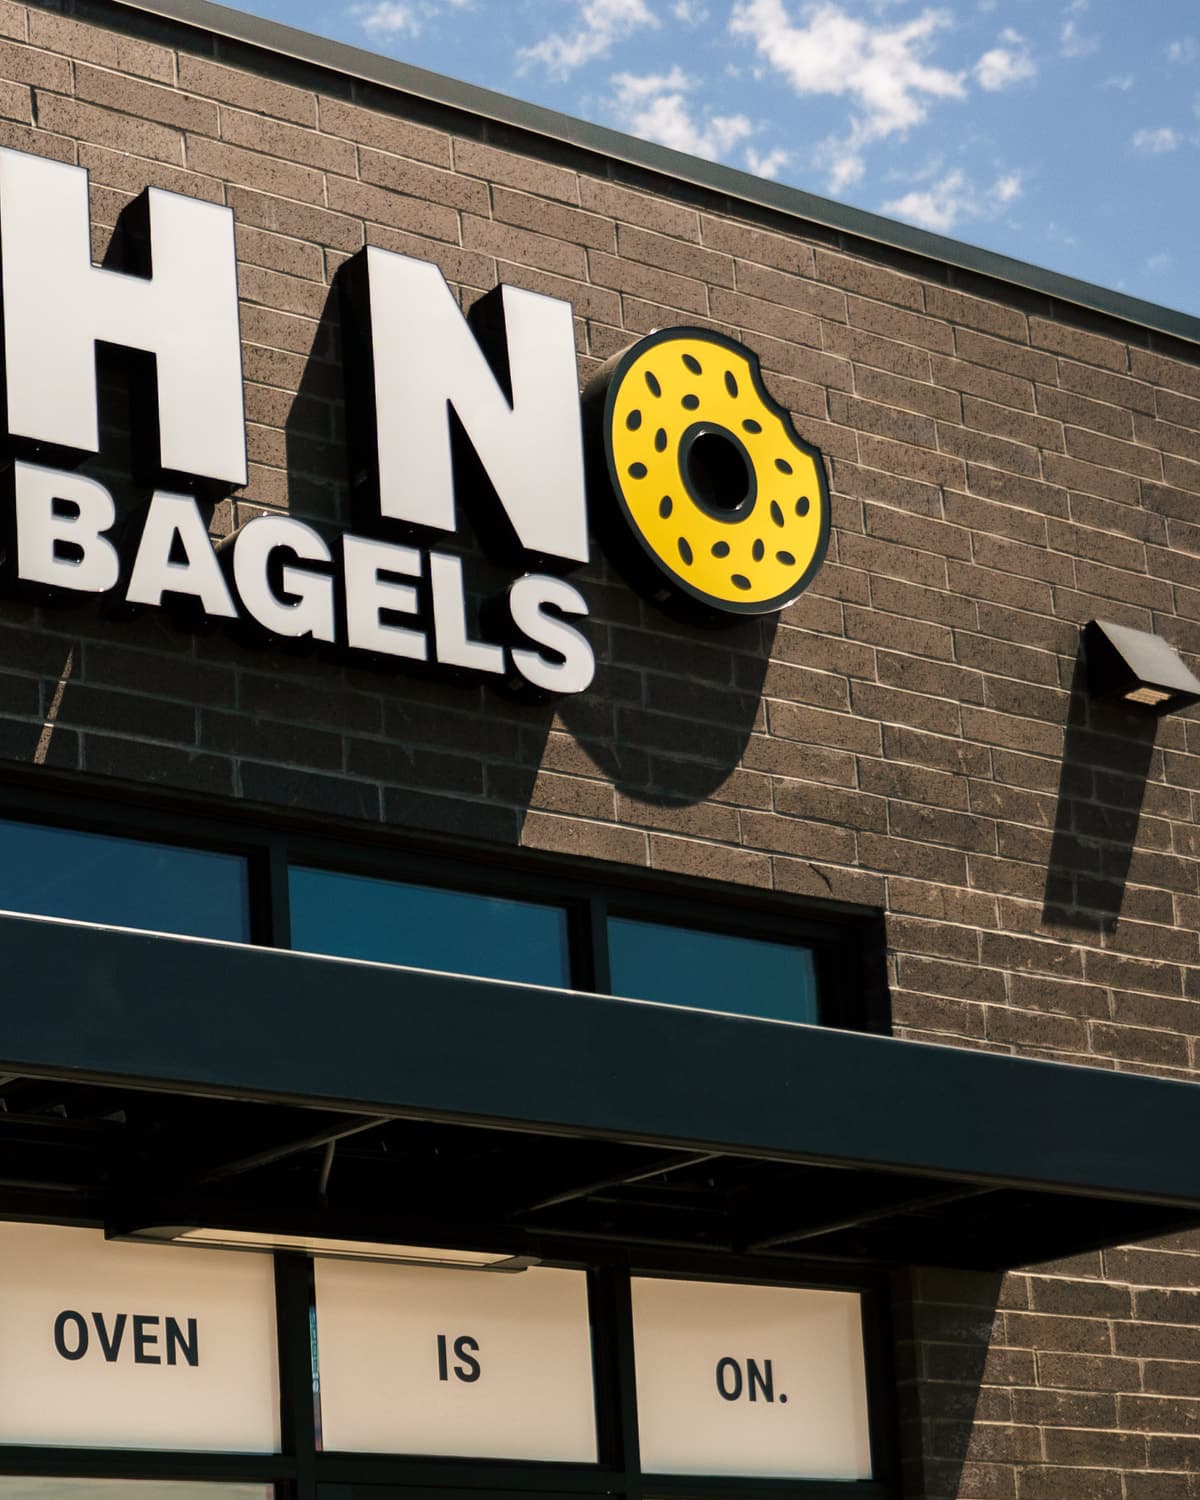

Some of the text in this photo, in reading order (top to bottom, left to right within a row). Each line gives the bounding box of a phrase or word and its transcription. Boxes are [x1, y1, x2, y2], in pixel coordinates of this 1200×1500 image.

[14, 460, 596, 693] BAGELS
[54, 1310, 199, 1367] OVEN
[437, 1335, 481, 1383] IS
[716, 1357, 788, 1403] ON.
